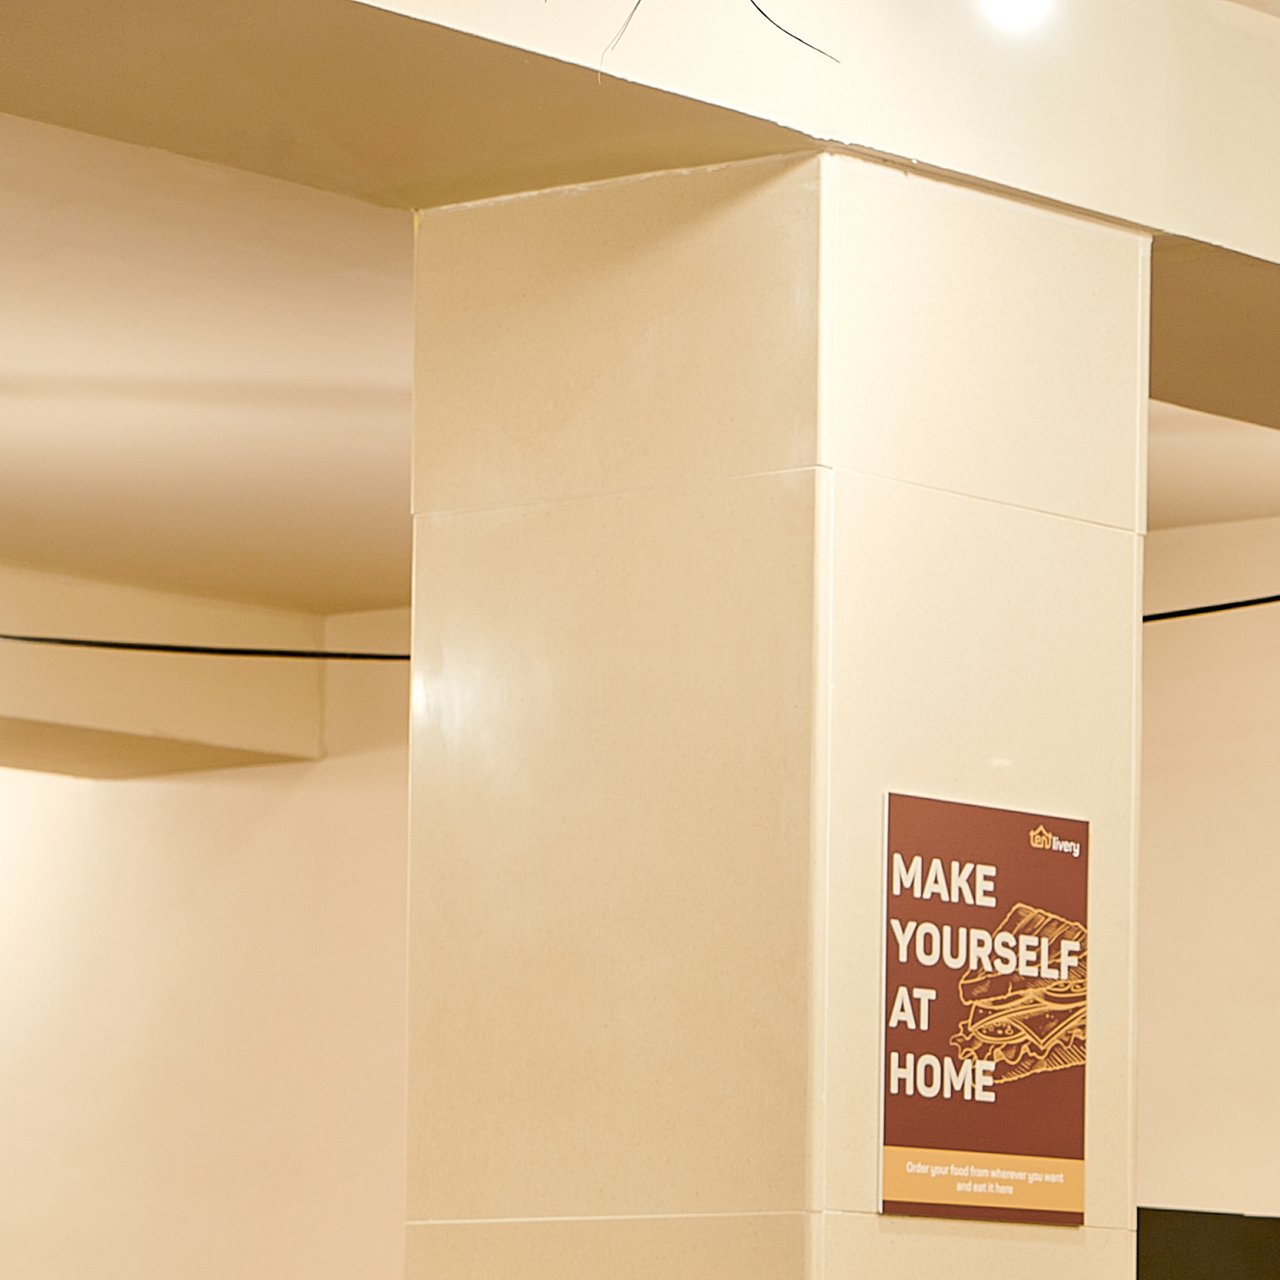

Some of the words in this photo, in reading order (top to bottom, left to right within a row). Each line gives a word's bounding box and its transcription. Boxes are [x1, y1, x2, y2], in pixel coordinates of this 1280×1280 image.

[892, 853, 997, 908] MAKE
[890, 919, 1080, 981] YOURSELF
[888, 986, 937, 1031] AT
[890, 1052, 996, 1102] HOME
[906, 1161, 929, 1174] Order
[930, 1165, 949, 1177] your
[950, 1164, 969, 1177] food
[970, 1165, 990, 1178] from
[990, 1167, 1027, 1181] wherever
[1028, 1172, 1043, 1184] you
[1044, 1172, 1065, 1183] want
[956, 1181, 972, 1192] and
[973, 1182, 986, 1193] eat
[987, 1182, 994, 1193] it
[995, 1183, 1014, 1194] here
